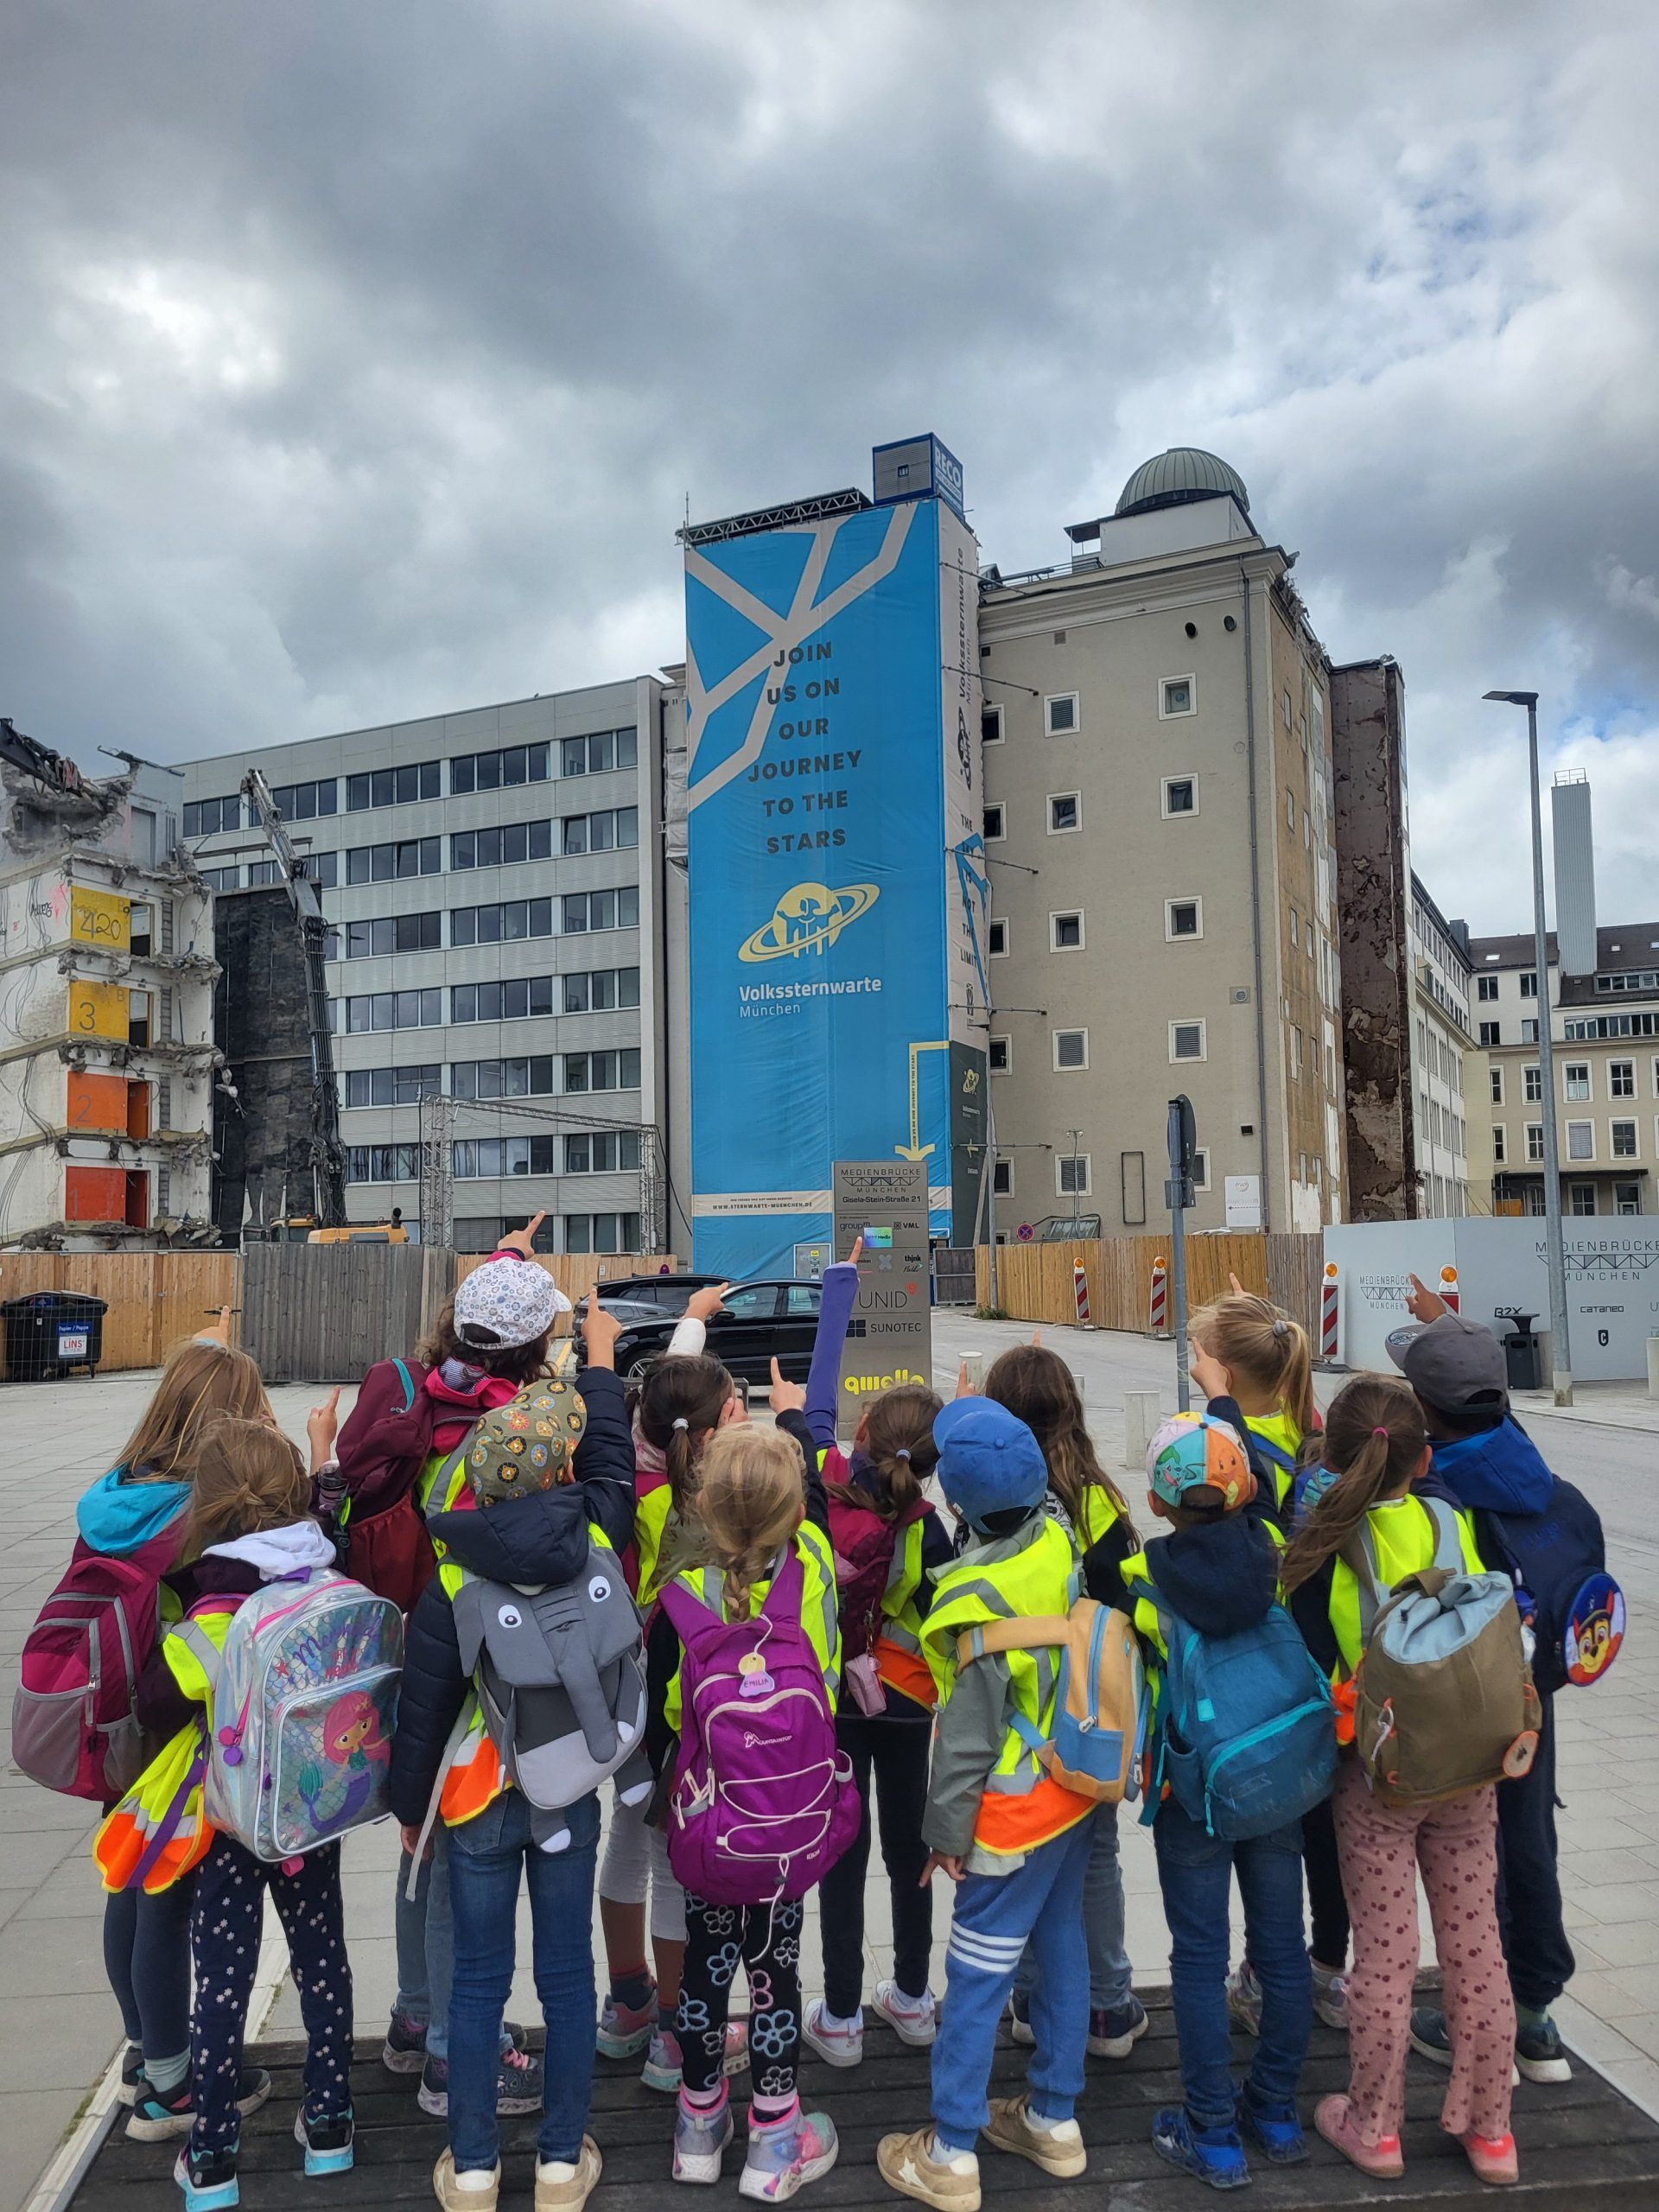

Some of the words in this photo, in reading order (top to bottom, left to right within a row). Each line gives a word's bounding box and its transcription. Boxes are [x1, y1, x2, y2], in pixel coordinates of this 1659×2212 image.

[935, 446, 962, 488] RECO
[773, 641, 832, 667] JOIN
[766, 685, 797, 705] US
[804, 677, 840, 698] ON
[779, 718, 829, 740] OUR
[747, 749, 862, 782] JOURNEY
[762, 798, 794, 817] TO
[802, 790, 849, 812] THE
[960, 813, 973, 832] THE
[766, 829, 846, 854] STARS
[80, 912, 121, 941] 420
[739, 976, 882, 1002] Volkssternwarte
[79, 1001, 95, 1031] 3
[740, 1002, 801, 1018] München
[75, 1094, 93, 1122] 2
[841, 1167, 922, 1176] MEDIENBRÜCKE
[1535, 1239, 1659, 1252] MDIENBRÜCKE
[1359, 1274, 1414, 1285] MEDIENBRÜCK
[1564, 1270, 1641, 1281] MÜNCHEN
[858, 1291, 908, 1309] UNID
[1494, 1307, 1523, 1318] B2X
[870, 1322, 923, 1333] SUNOTEC
[743, 1678, 769, 1688] EMILIA
